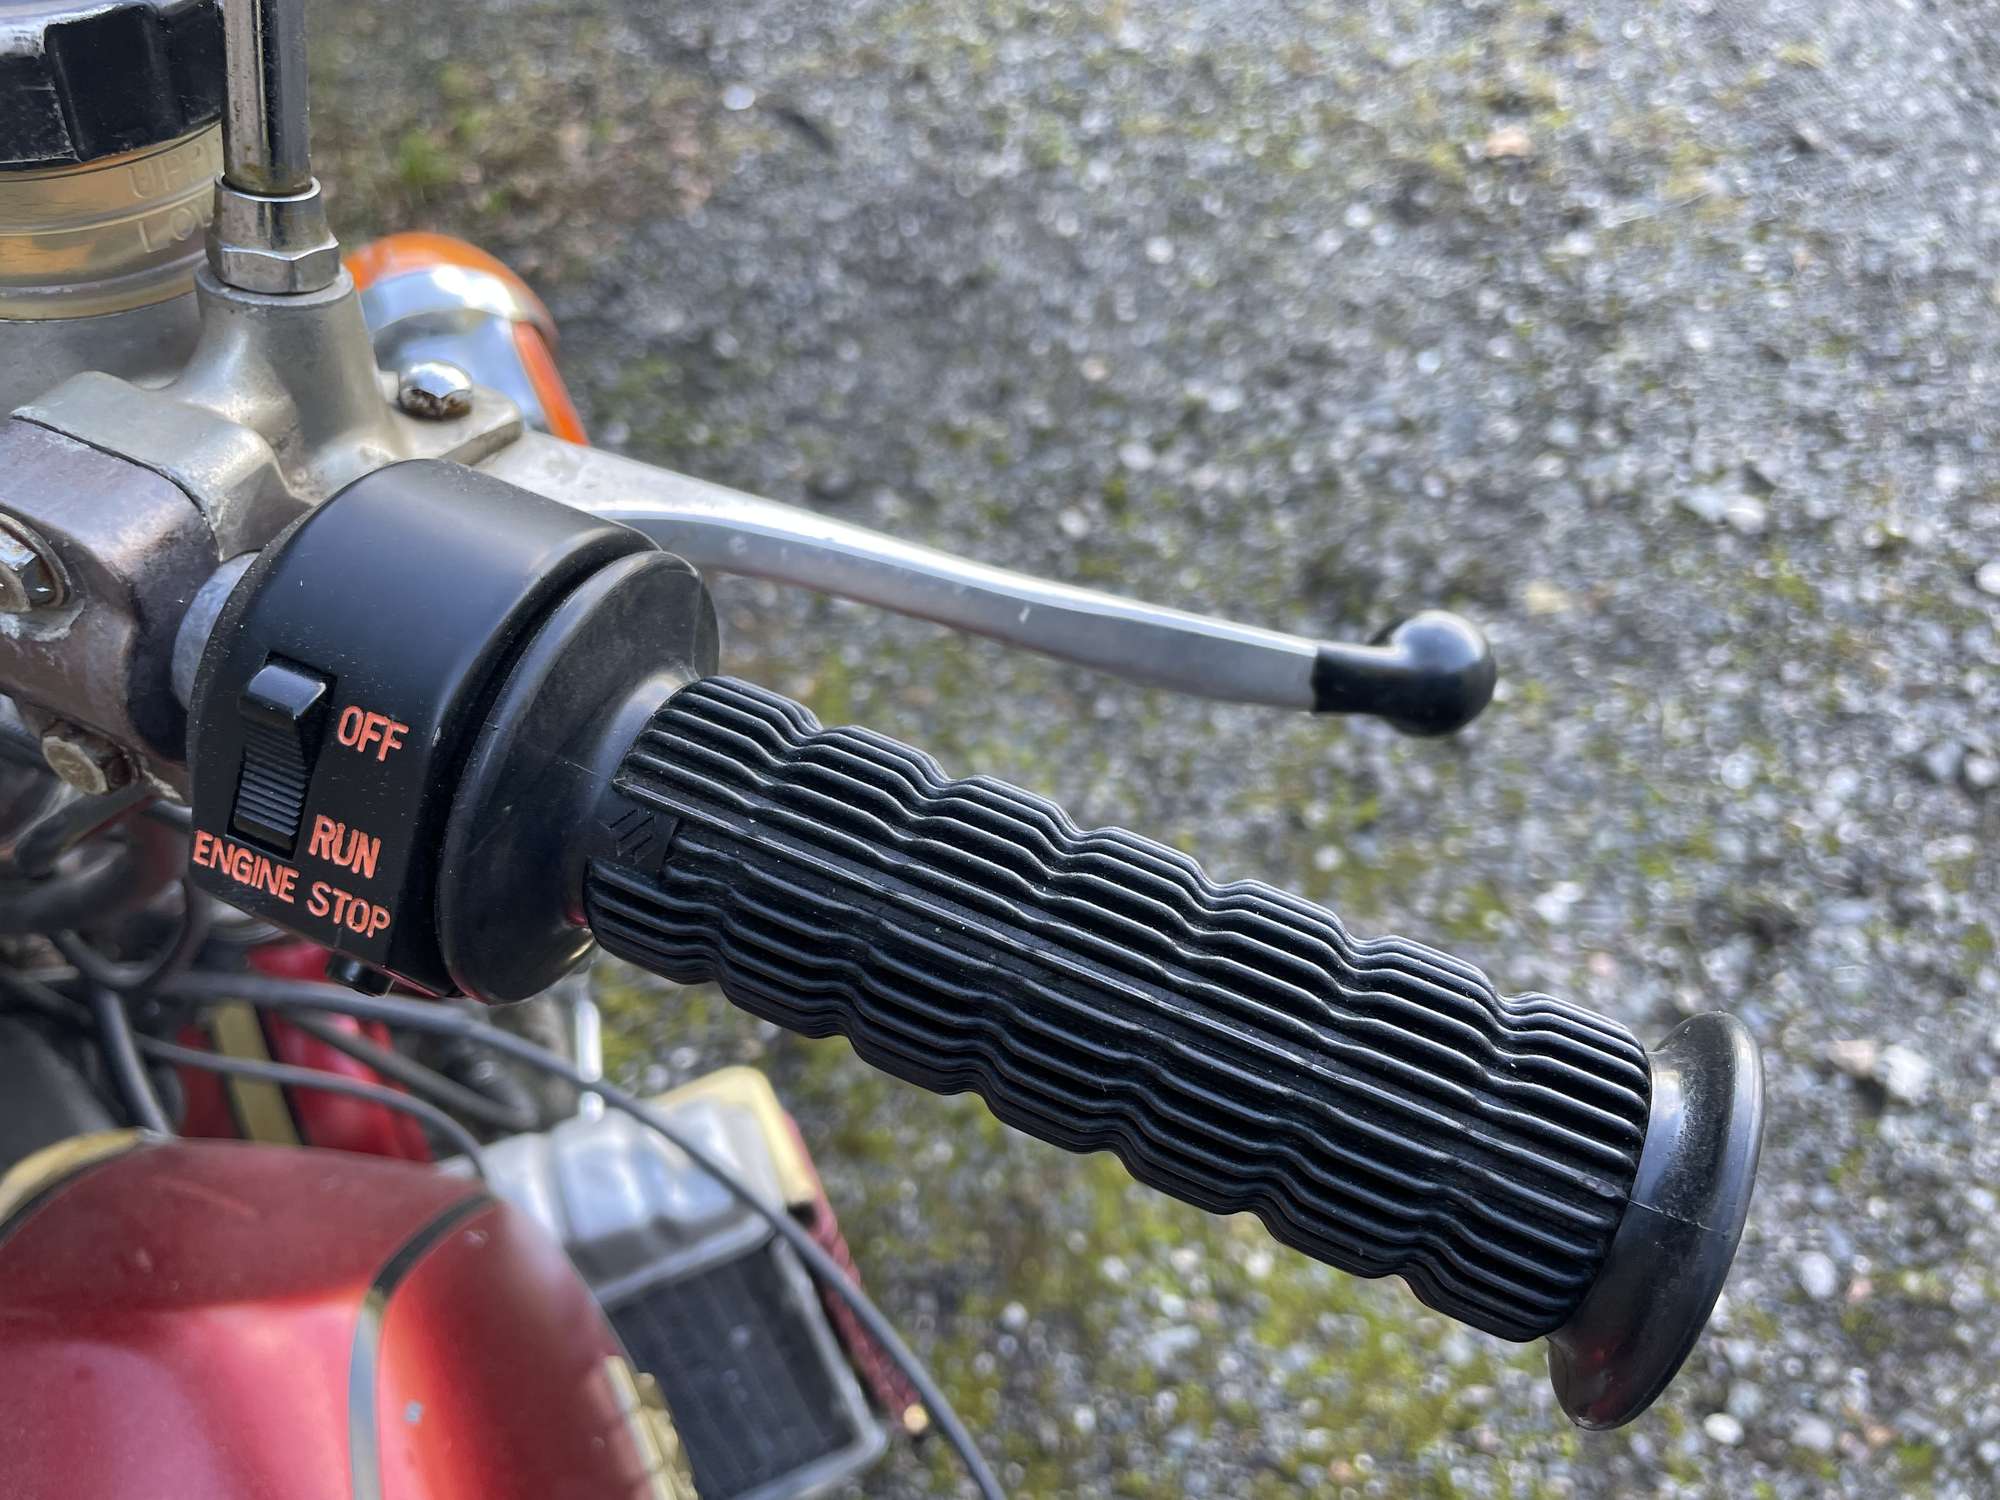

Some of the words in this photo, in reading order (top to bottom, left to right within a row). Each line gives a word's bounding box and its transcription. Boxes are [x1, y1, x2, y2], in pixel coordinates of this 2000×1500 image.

[338, 705, 409, 761] OFF
[308, 815, 381, 879] RUN
[192, 830, 300, 903] ENGINE
[306, 881, 391, 938] STOP
